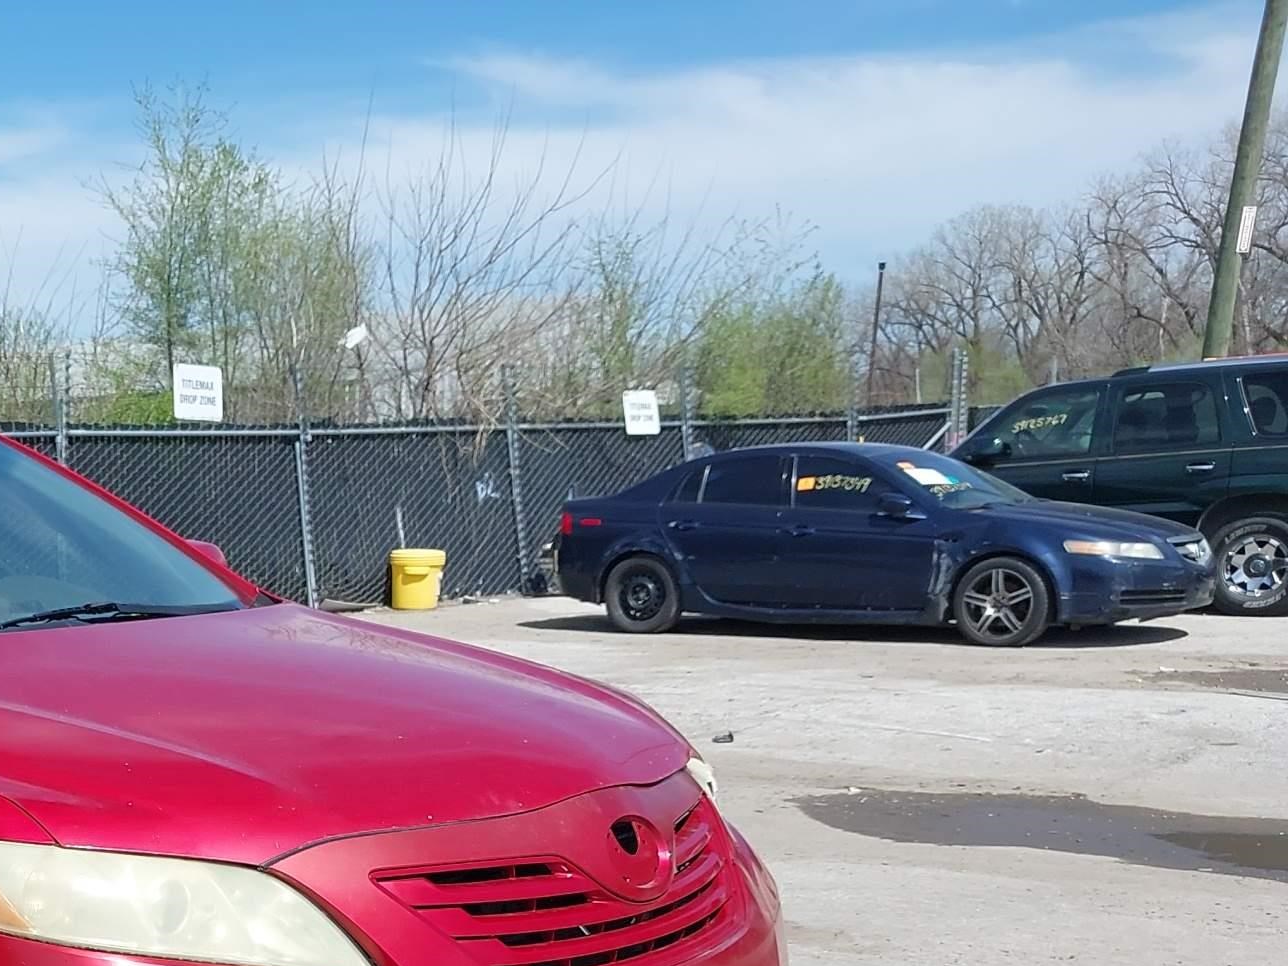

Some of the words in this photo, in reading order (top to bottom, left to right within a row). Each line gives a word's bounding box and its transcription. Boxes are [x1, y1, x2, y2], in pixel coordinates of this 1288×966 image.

[181, 378, 215, 390] TITLEMAX
[179, 393, 197, 405] DROP
[199, 395, 216, 407] ZONE
